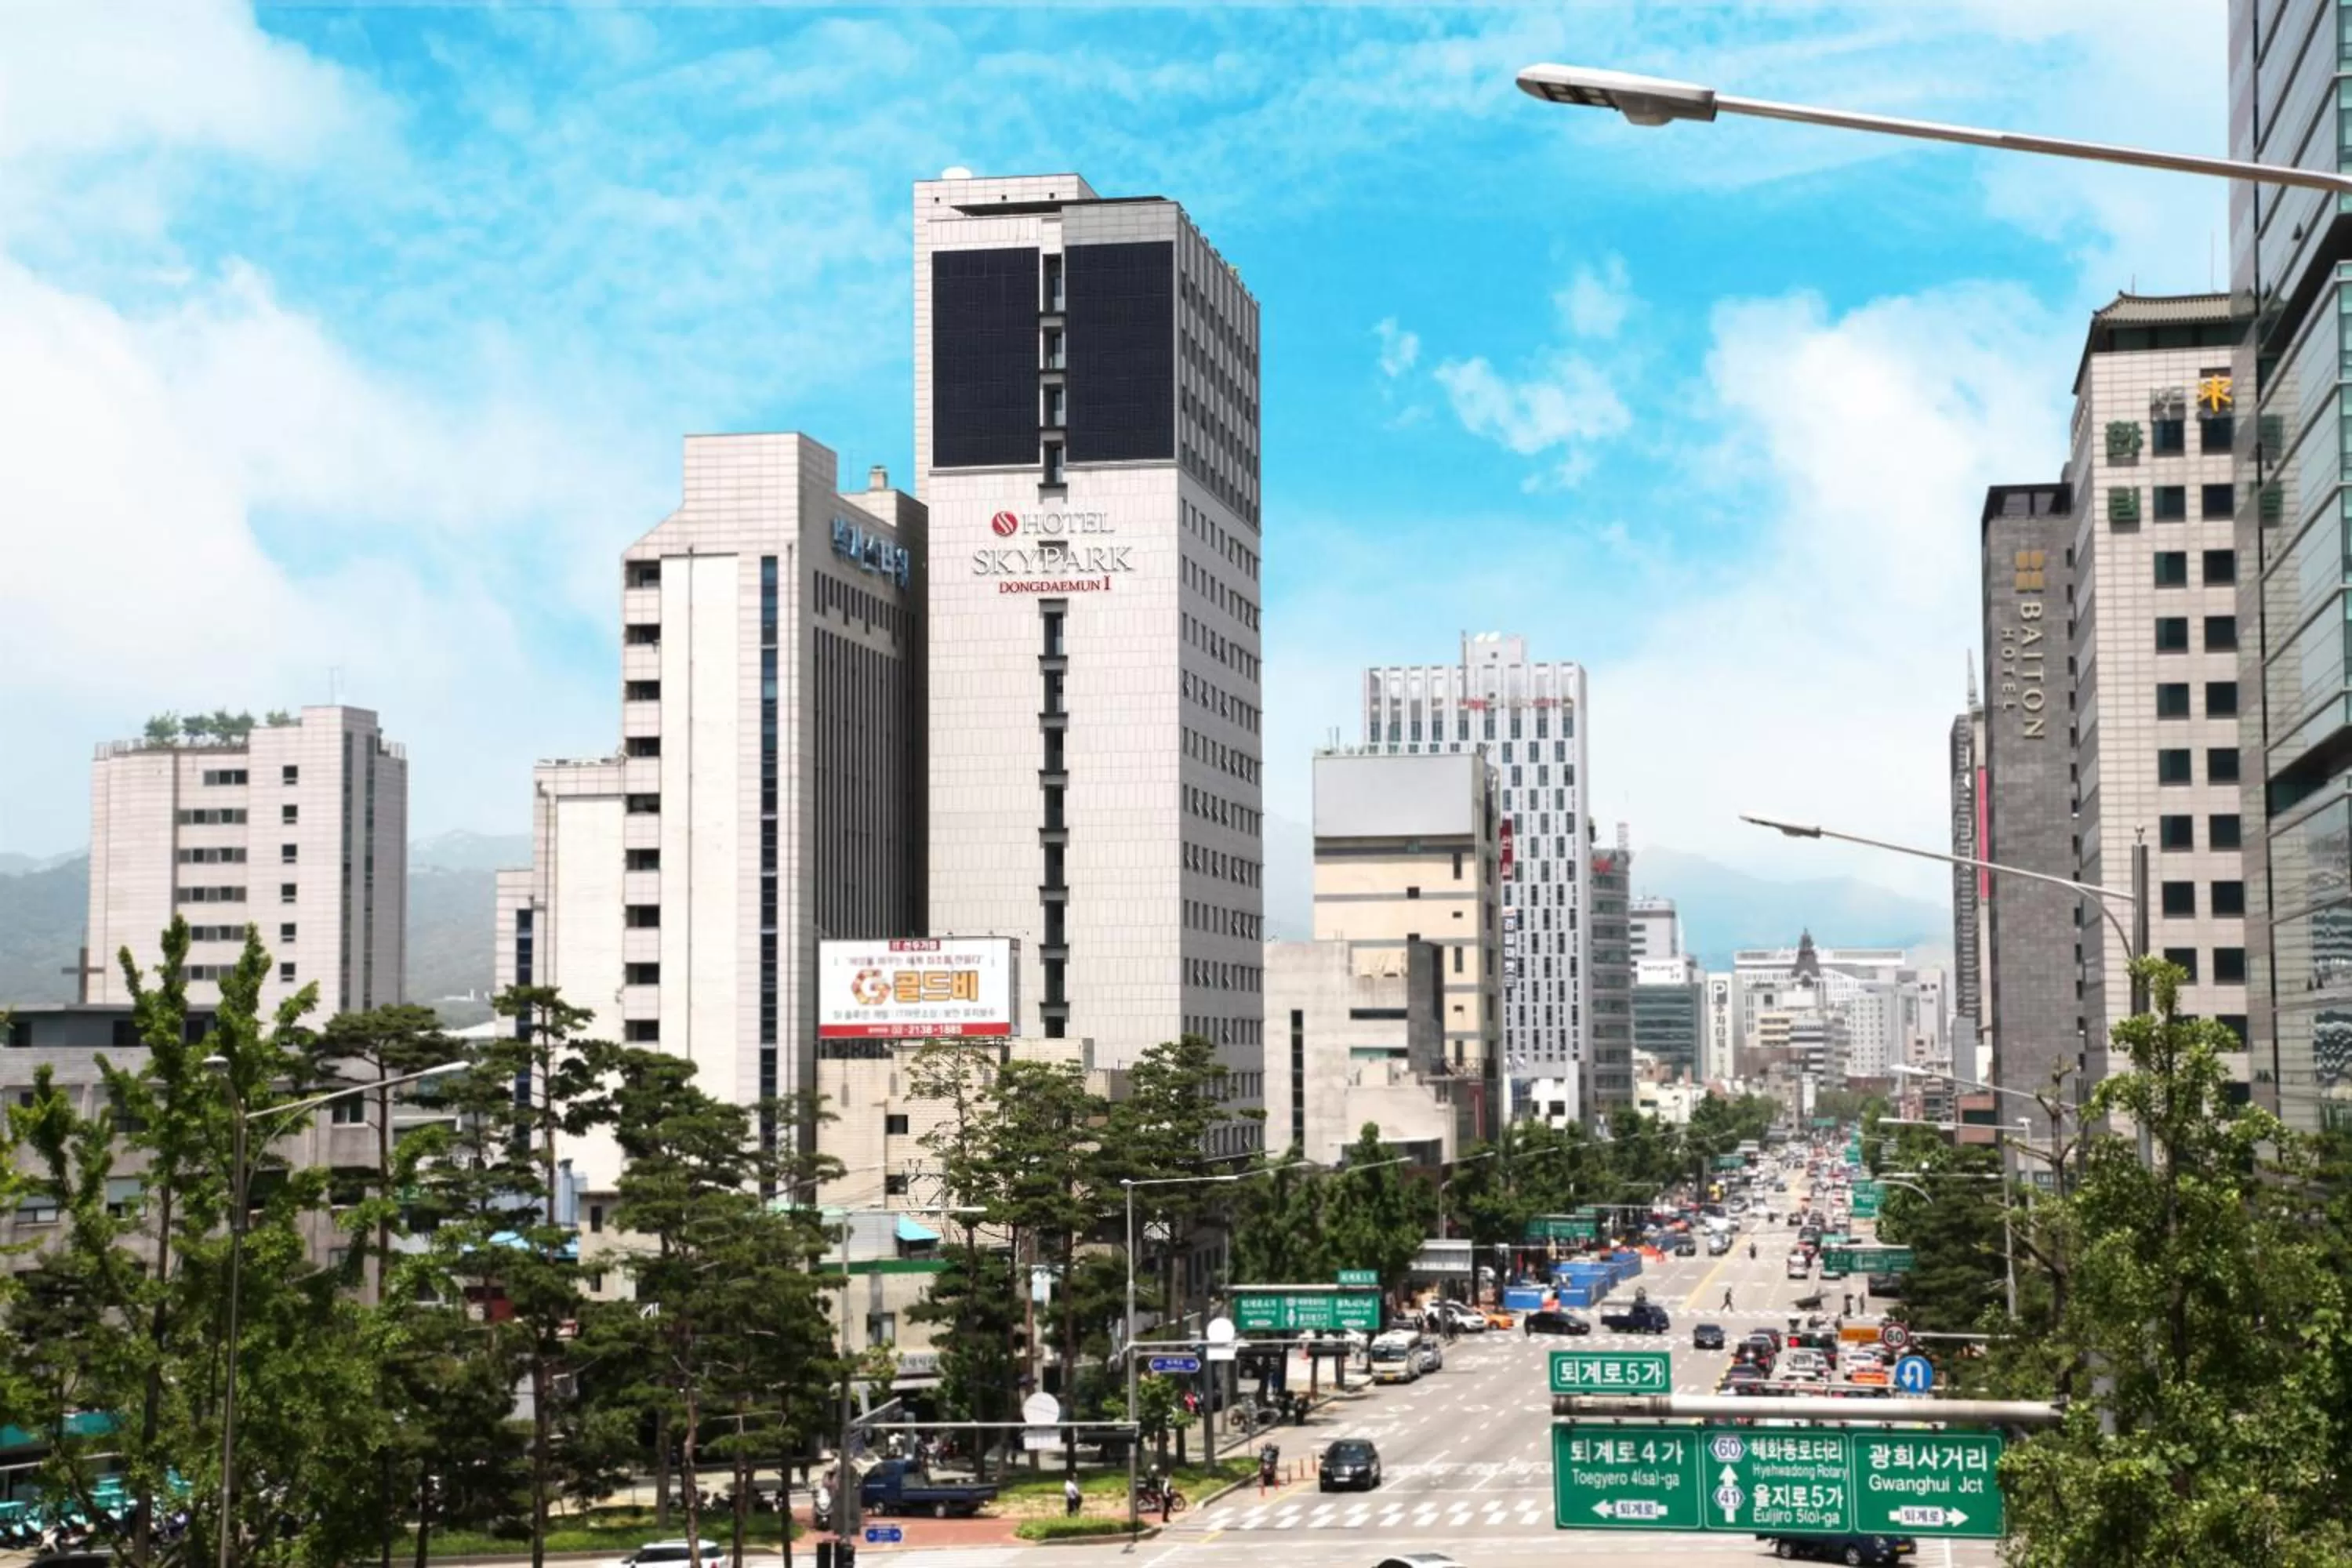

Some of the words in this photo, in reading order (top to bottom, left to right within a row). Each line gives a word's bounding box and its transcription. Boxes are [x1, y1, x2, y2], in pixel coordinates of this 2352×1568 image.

[1022, 512, 1116, 535] HOTEL
[973, 546, 1136, 575] SKYPARK
[999, 579, 1101, 593] DONGDAEMUN
[2001, 628, 2016, 712] HOTEL
[2020, 601, 2045, 740] BAITON
[893, 970, 979, 1004] 골드비
[1886, 1330, 1904, 1343] 60
[1560, 1360, 1663, 1385] 퇴계로5가
[1718, 1439, 1738, 1457] 60
[1751, 1438, 1843, 1462] 혜화동로터리
[1868, 1443, 1988, 1472] 광희사거리
[1571, 1468, 1628, 1490] Toegyero
[1631, 1468, 1680, 1490] 4(sa)-ga
[1752, 1463, 1816, 1480] Hyehwadong
[1817, 1464, 1849, 1481] Rotary
[1752, 1483, 1844, 1509] 을지로5가
[1868, 1473, 1951, 1496] Gwanghui
[1958, 1475, 1984, 1494] Jct
[1721, 1490, 1737, 1504] 41
[1904, 1510, 1940, 1523] 퇴계로
